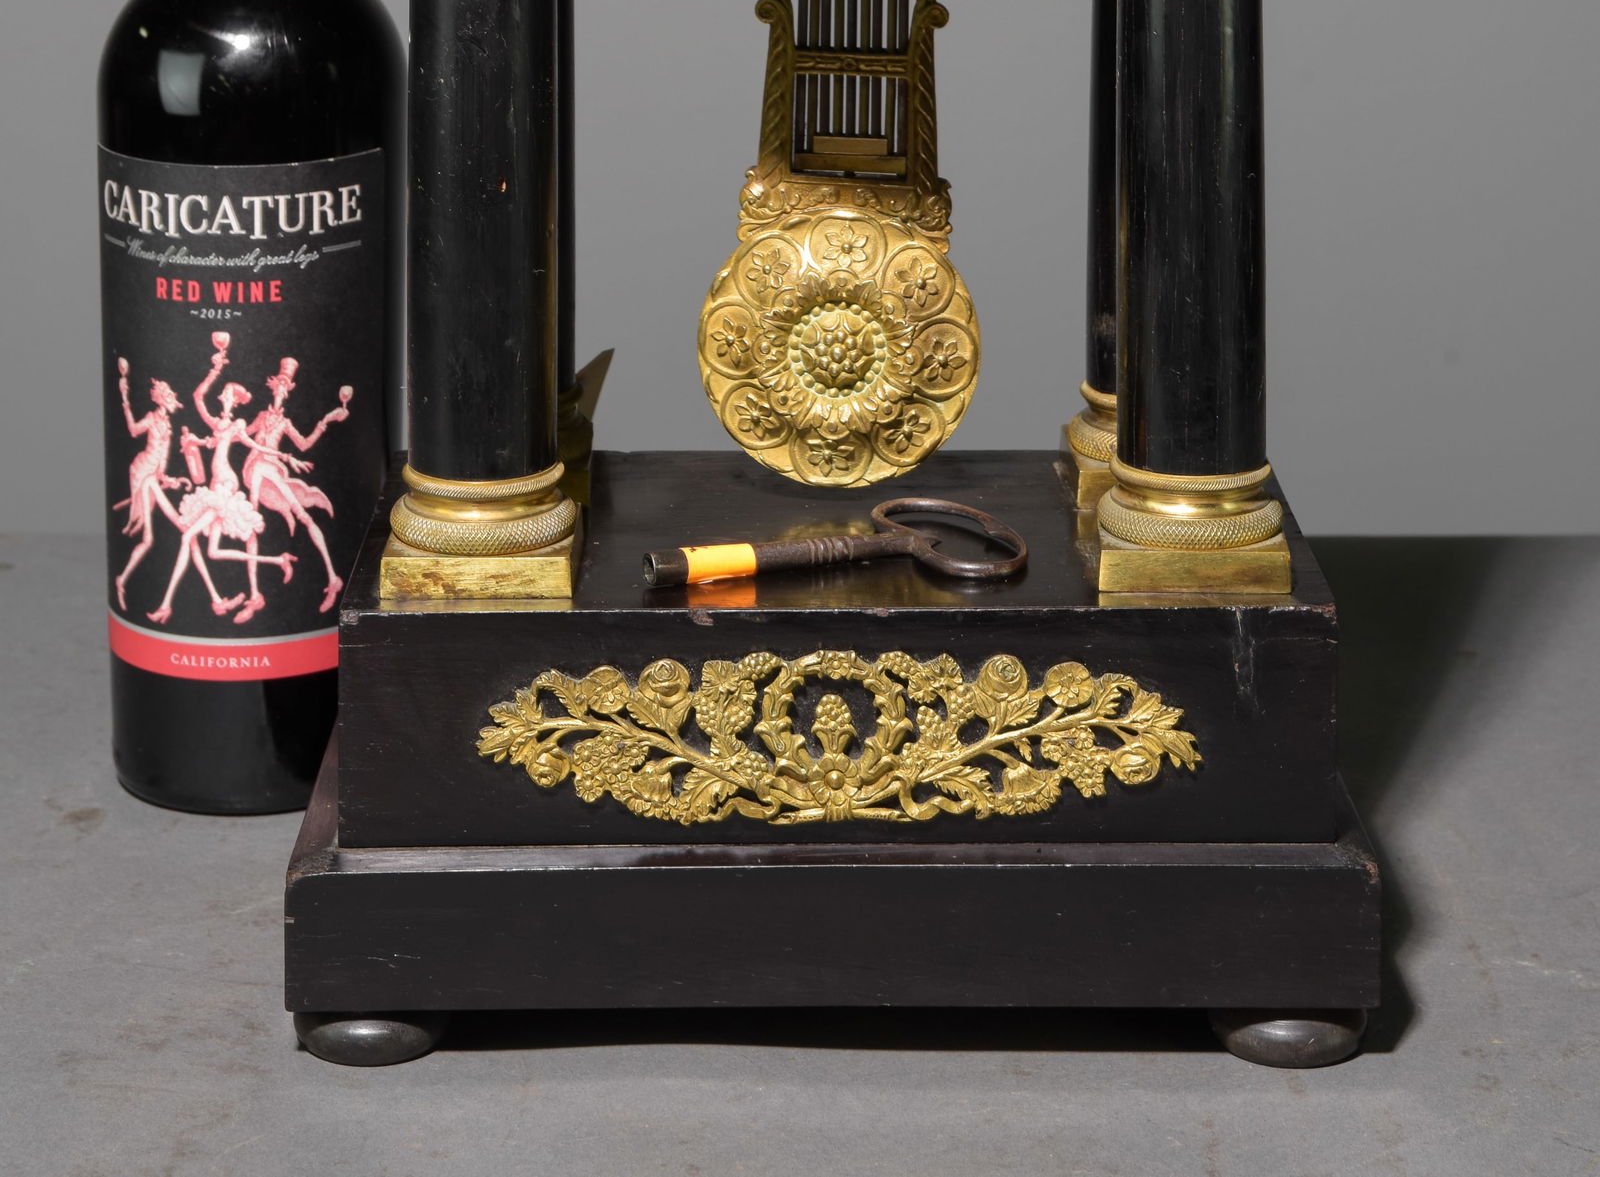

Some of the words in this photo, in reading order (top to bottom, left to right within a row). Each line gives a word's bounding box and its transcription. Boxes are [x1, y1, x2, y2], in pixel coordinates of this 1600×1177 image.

[103, 179, 363, 240] CARICATURE
[125, 235, 157, 262] Wines
[157, 244, 175, 267] of
[168, 245, 225, 267] character
[226, 247, 261, 267] with
[253, 250, 294, 273] great
[293, 243, 320, 270] legs
[155, 276, 201, 302] RED
[212, 280, 283, 304] WINE
[170, 652, 272, 669] CALIFORNIA
